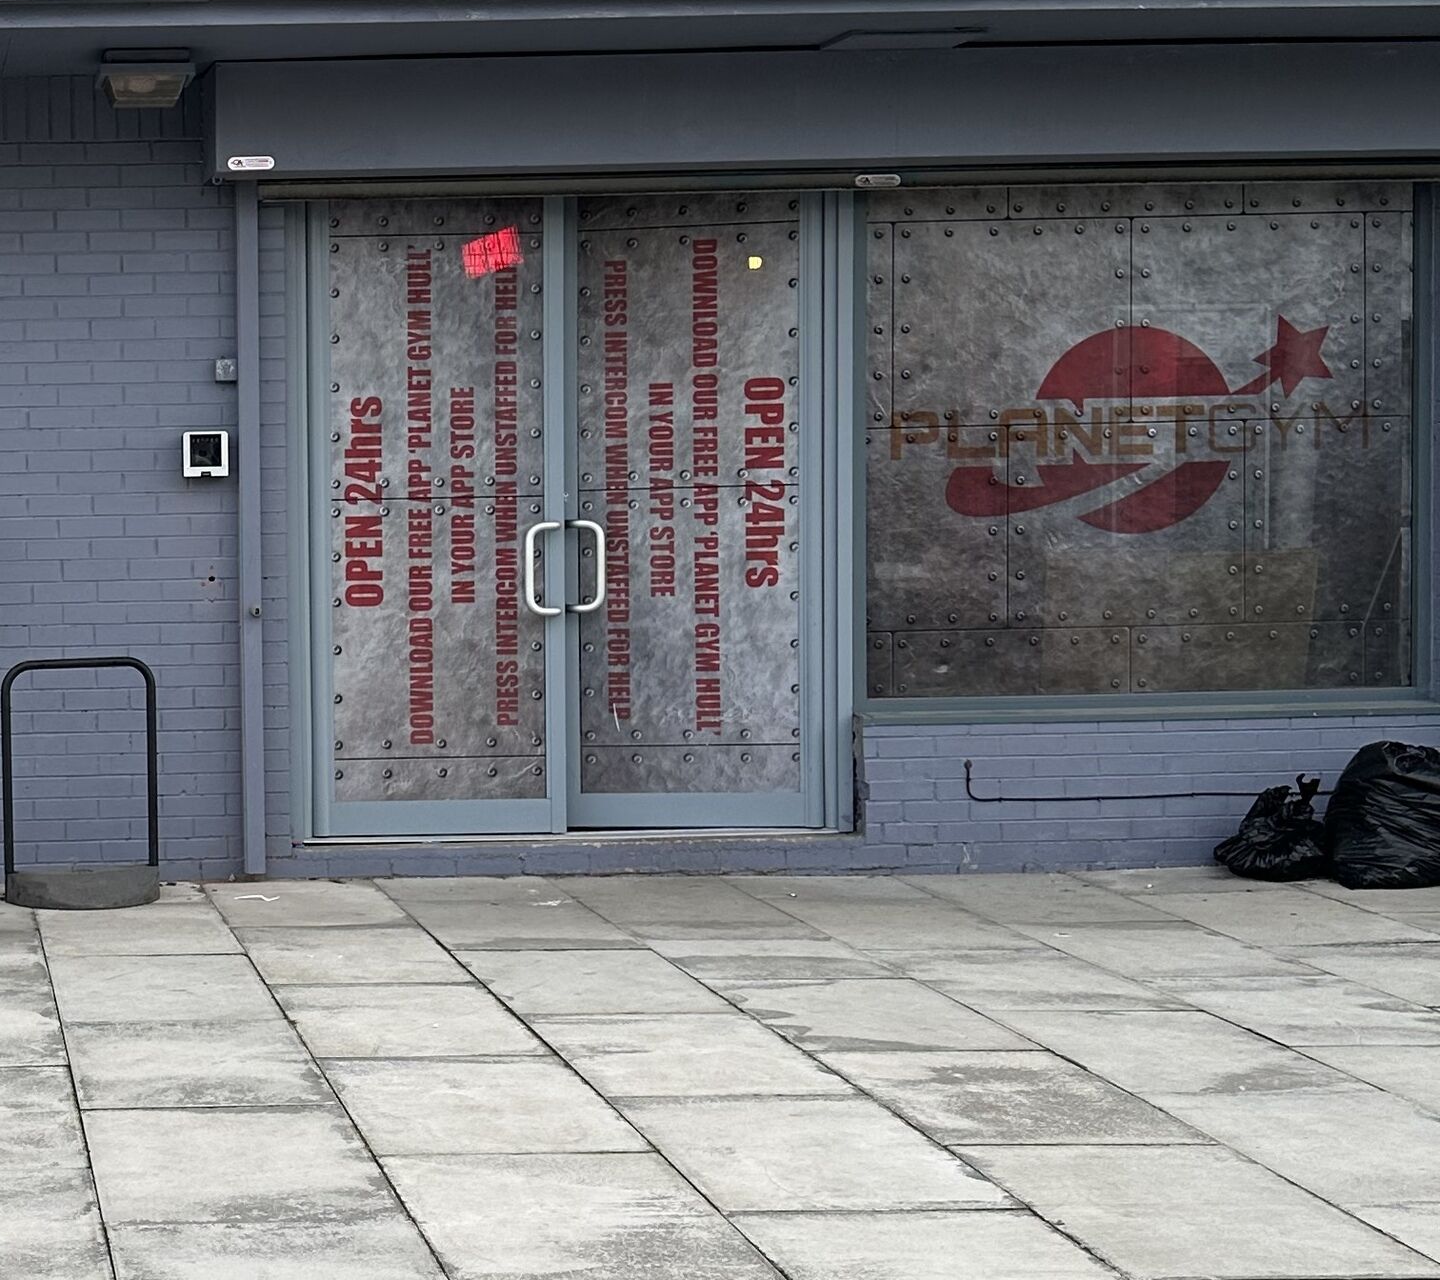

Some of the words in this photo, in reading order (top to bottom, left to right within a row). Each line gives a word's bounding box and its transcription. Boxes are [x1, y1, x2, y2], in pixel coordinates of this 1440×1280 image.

[605, 260, 629, 326] PRESS
[693, 239, 720, 368] DOWNLOAD
[408, 310, 434, 361] GYM
[495, 315, 519, 355] FOR
[605, 332, 629, 439] INTERCOM
[649, 383, 675, 405] IN
[693, 374, 720, 420] OUR
[450, 386, 475, 459] STORE
[495, 361, 519, 476] UNSTAFFED
[649, 411, 675, 471] YOUR
[744, 377, 785, 469] OPEN
[344, 396, 384, 505] 24hrs
[408, 459, 434, 503] APP
[605, 444, 629, 505] WHEN
[693, 426, 720, 477] FREE
[450, 465, 475, 508] APP
[495, 479, 519, 542] WHEN
[649, 477, 675, 521] APP
[693, 482, 720, 526] APP
[344, 515, 384, 607] OPEN
[408, 508, 434, 559] FREE
[450, 514, 475, 575] YOUR
[649, 526, 675, 597] STORE
[744, 479, 785, 588] 24hrs
[408, 564, 434, 612] OUR
[450, 580, 475, 604] IN
[605, 510, 629, 623] UNSTAFFED
[495, 548, 519, 655] INTERCOM
[605, 628, 629, 666] FOR
[693, 623, 720, 672] GYM
[408, 617, 434, 745] DOWNLOAD
[495, 661, 519, 726] PRESS
[605, 672, 629, 720] HELP
